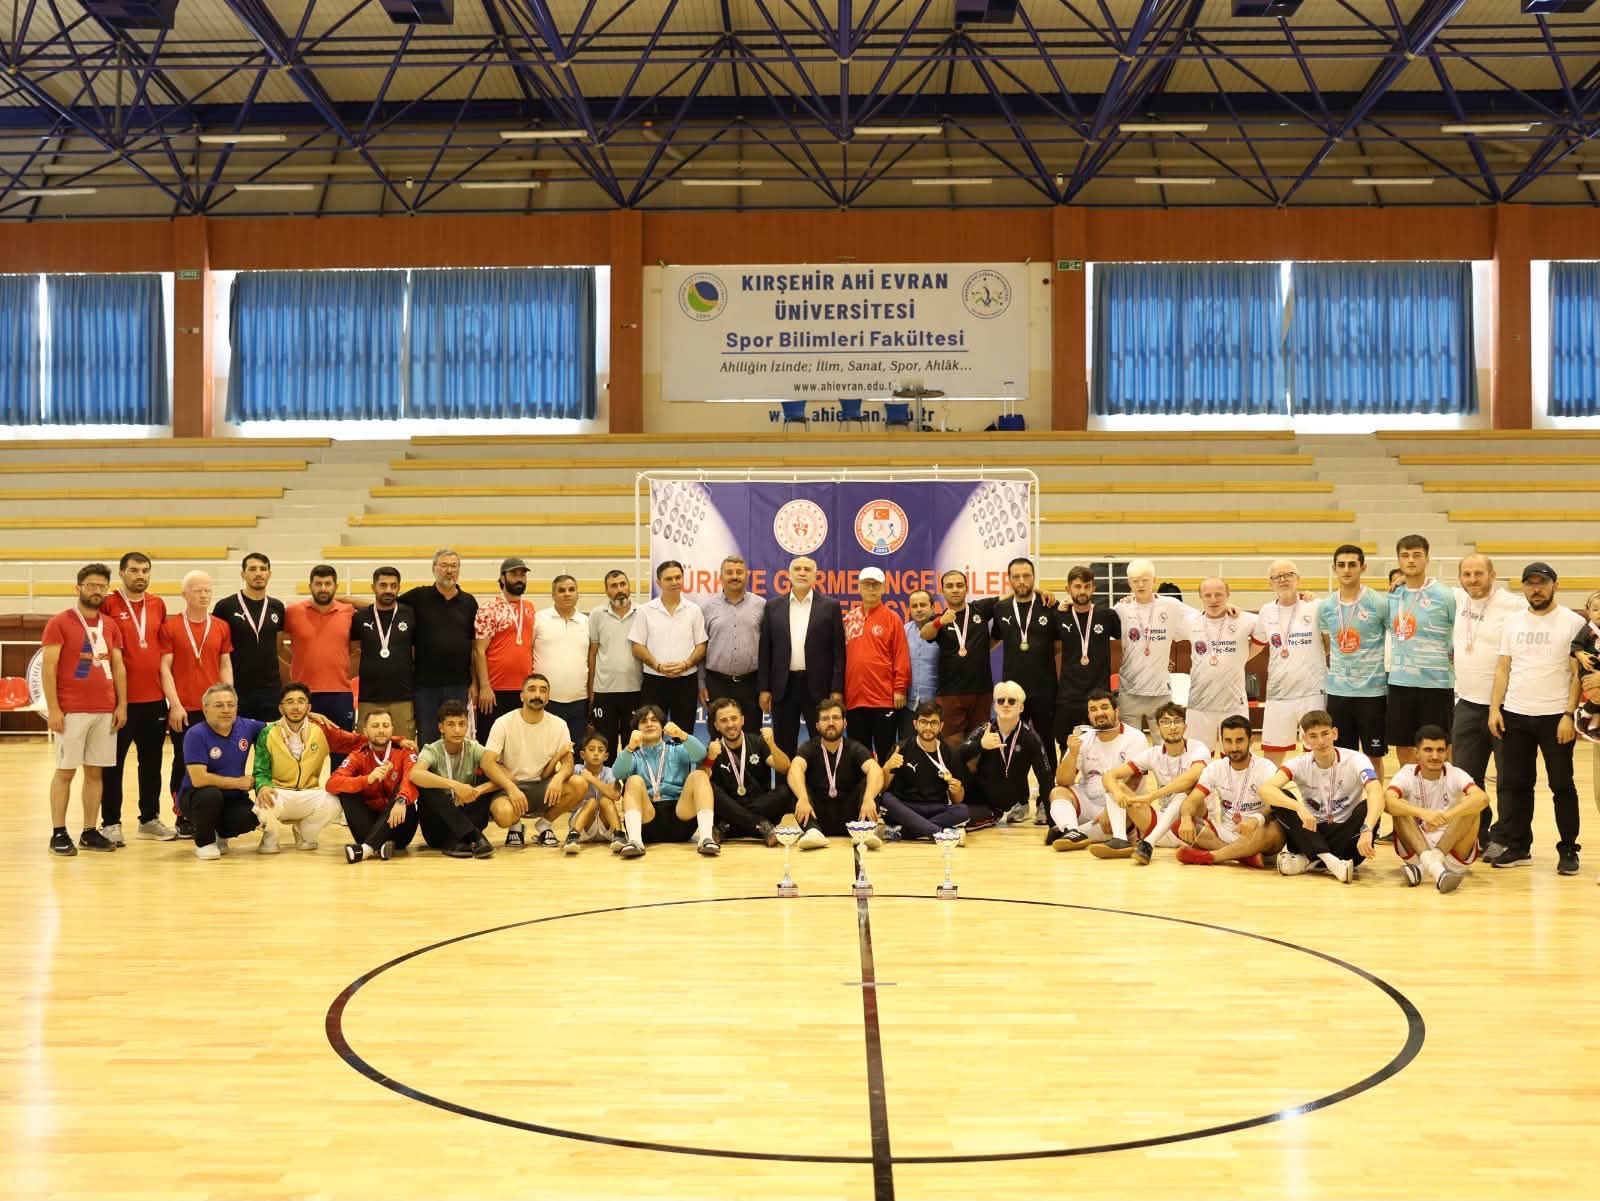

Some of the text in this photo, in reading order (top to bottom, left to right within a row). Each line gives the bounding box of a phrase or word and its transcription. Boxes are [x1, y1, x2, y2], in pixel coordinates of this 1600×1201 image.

[741, 269, 949, 295] KIRŞEHİR AHİ EVRAN
[775, 298, 915, 321] ÜNİVERSİTESİ
[726, 329, 965, 351] Spor Bilimleri Fakültesi
[720, 360, 768, 375] Ahiliğin
[816, 359, 844, 373] İlim,
[848, 360, 887, 373] Sanat,
[890, 360, 921, 373] Spor,
[793, 380, 893, 392] www.ahievran.edu.t
[682, 564, 767, 594] ÜRKE
[773, 569, 860, 595] GRME
[1516, 632, 1553, 645] COOL
[592, 707, 603, 718] 10
